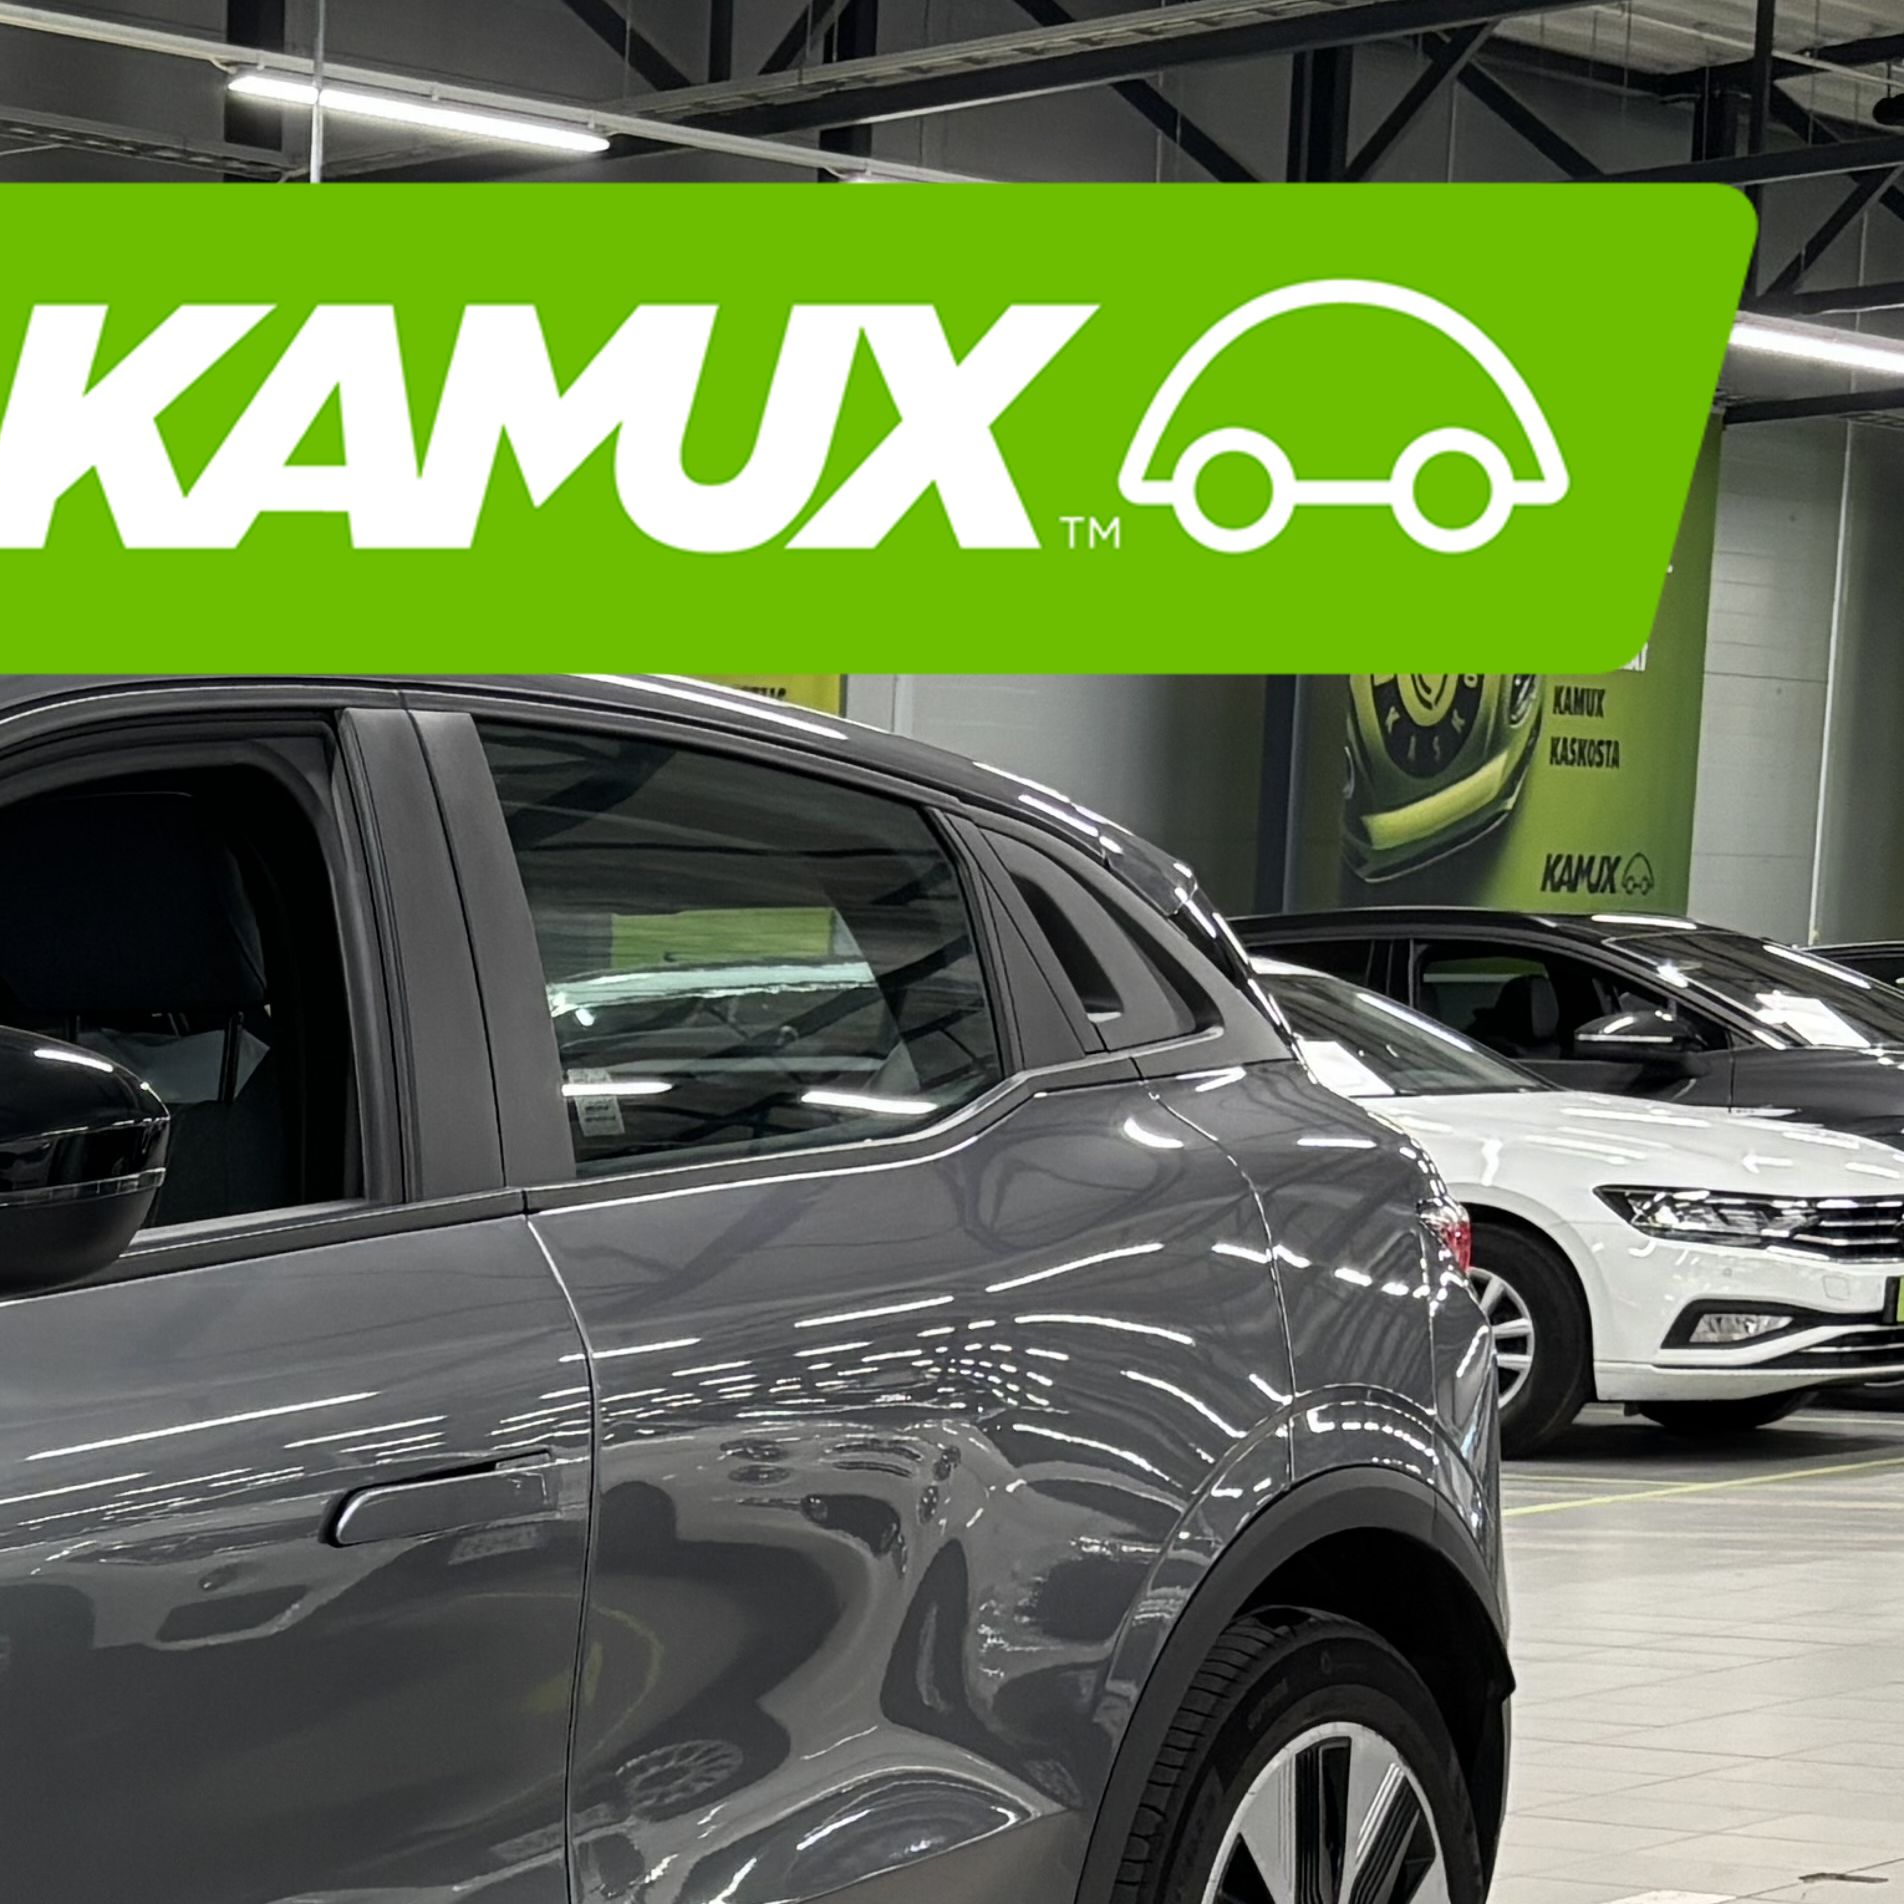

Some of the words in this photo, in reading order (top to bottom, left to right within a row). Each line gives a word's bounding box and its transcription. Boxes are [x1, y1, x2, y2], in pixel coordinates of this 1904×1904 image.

[1553, 685, 1606, 718] KAMUX
[1550, 736, 1620, 769] KASKOSTA
[1540, 853, 1622, 894] KAMUX
